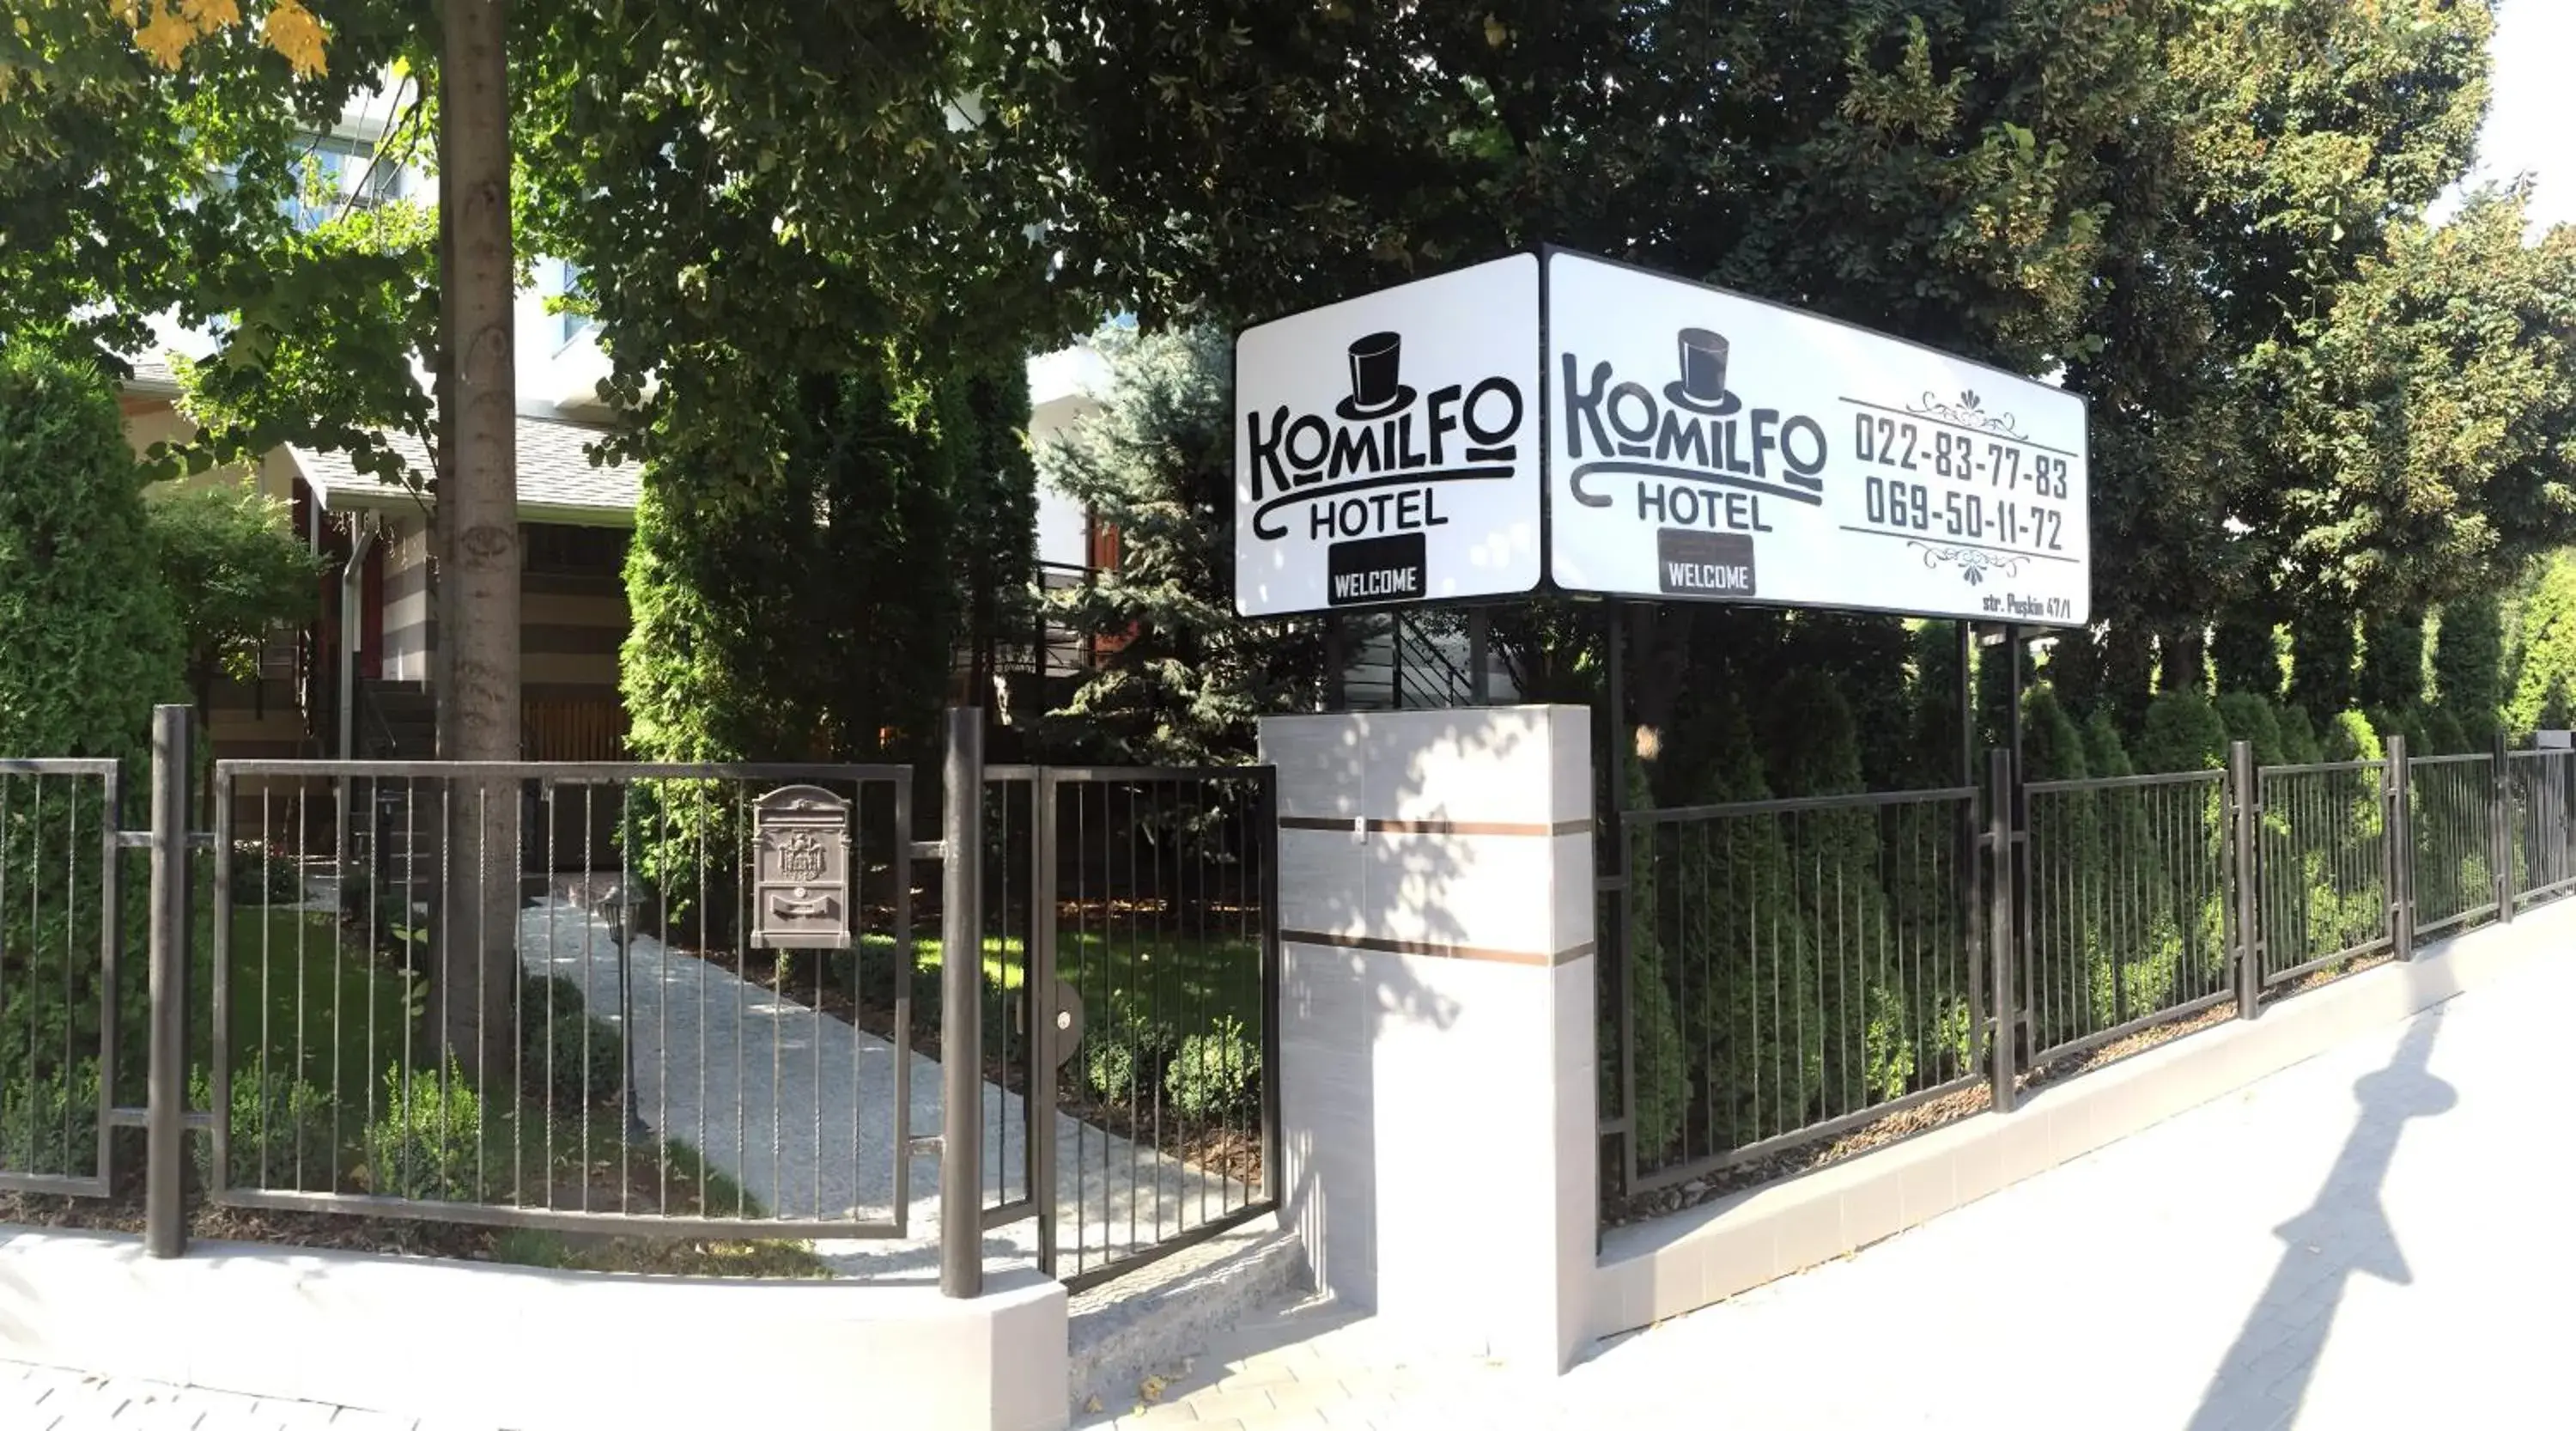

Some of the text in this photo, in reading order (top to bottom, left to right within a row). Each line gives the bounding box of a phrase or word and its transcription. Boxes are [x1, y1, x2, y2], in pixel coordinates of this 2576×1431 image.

[1248, 376, 1523, 502] KOMILFO
[1562, 352, 1827, 491] KOMILFO
[1856, 412, 2068, 499] 022-83-77-83
[1310, 487, 1449, 540] HOTEL
[1637, 481, 1773, 533] HOTEL
[1866, 476, 2062, 551] 069-50-11-72
[1334, 567, 1418, 599] WELCOME
[1668, 563, 1749, 589] WELCOME
[1983, 594, 2005, 612] str.
[2047, 597, 2070, 618] 47/1
